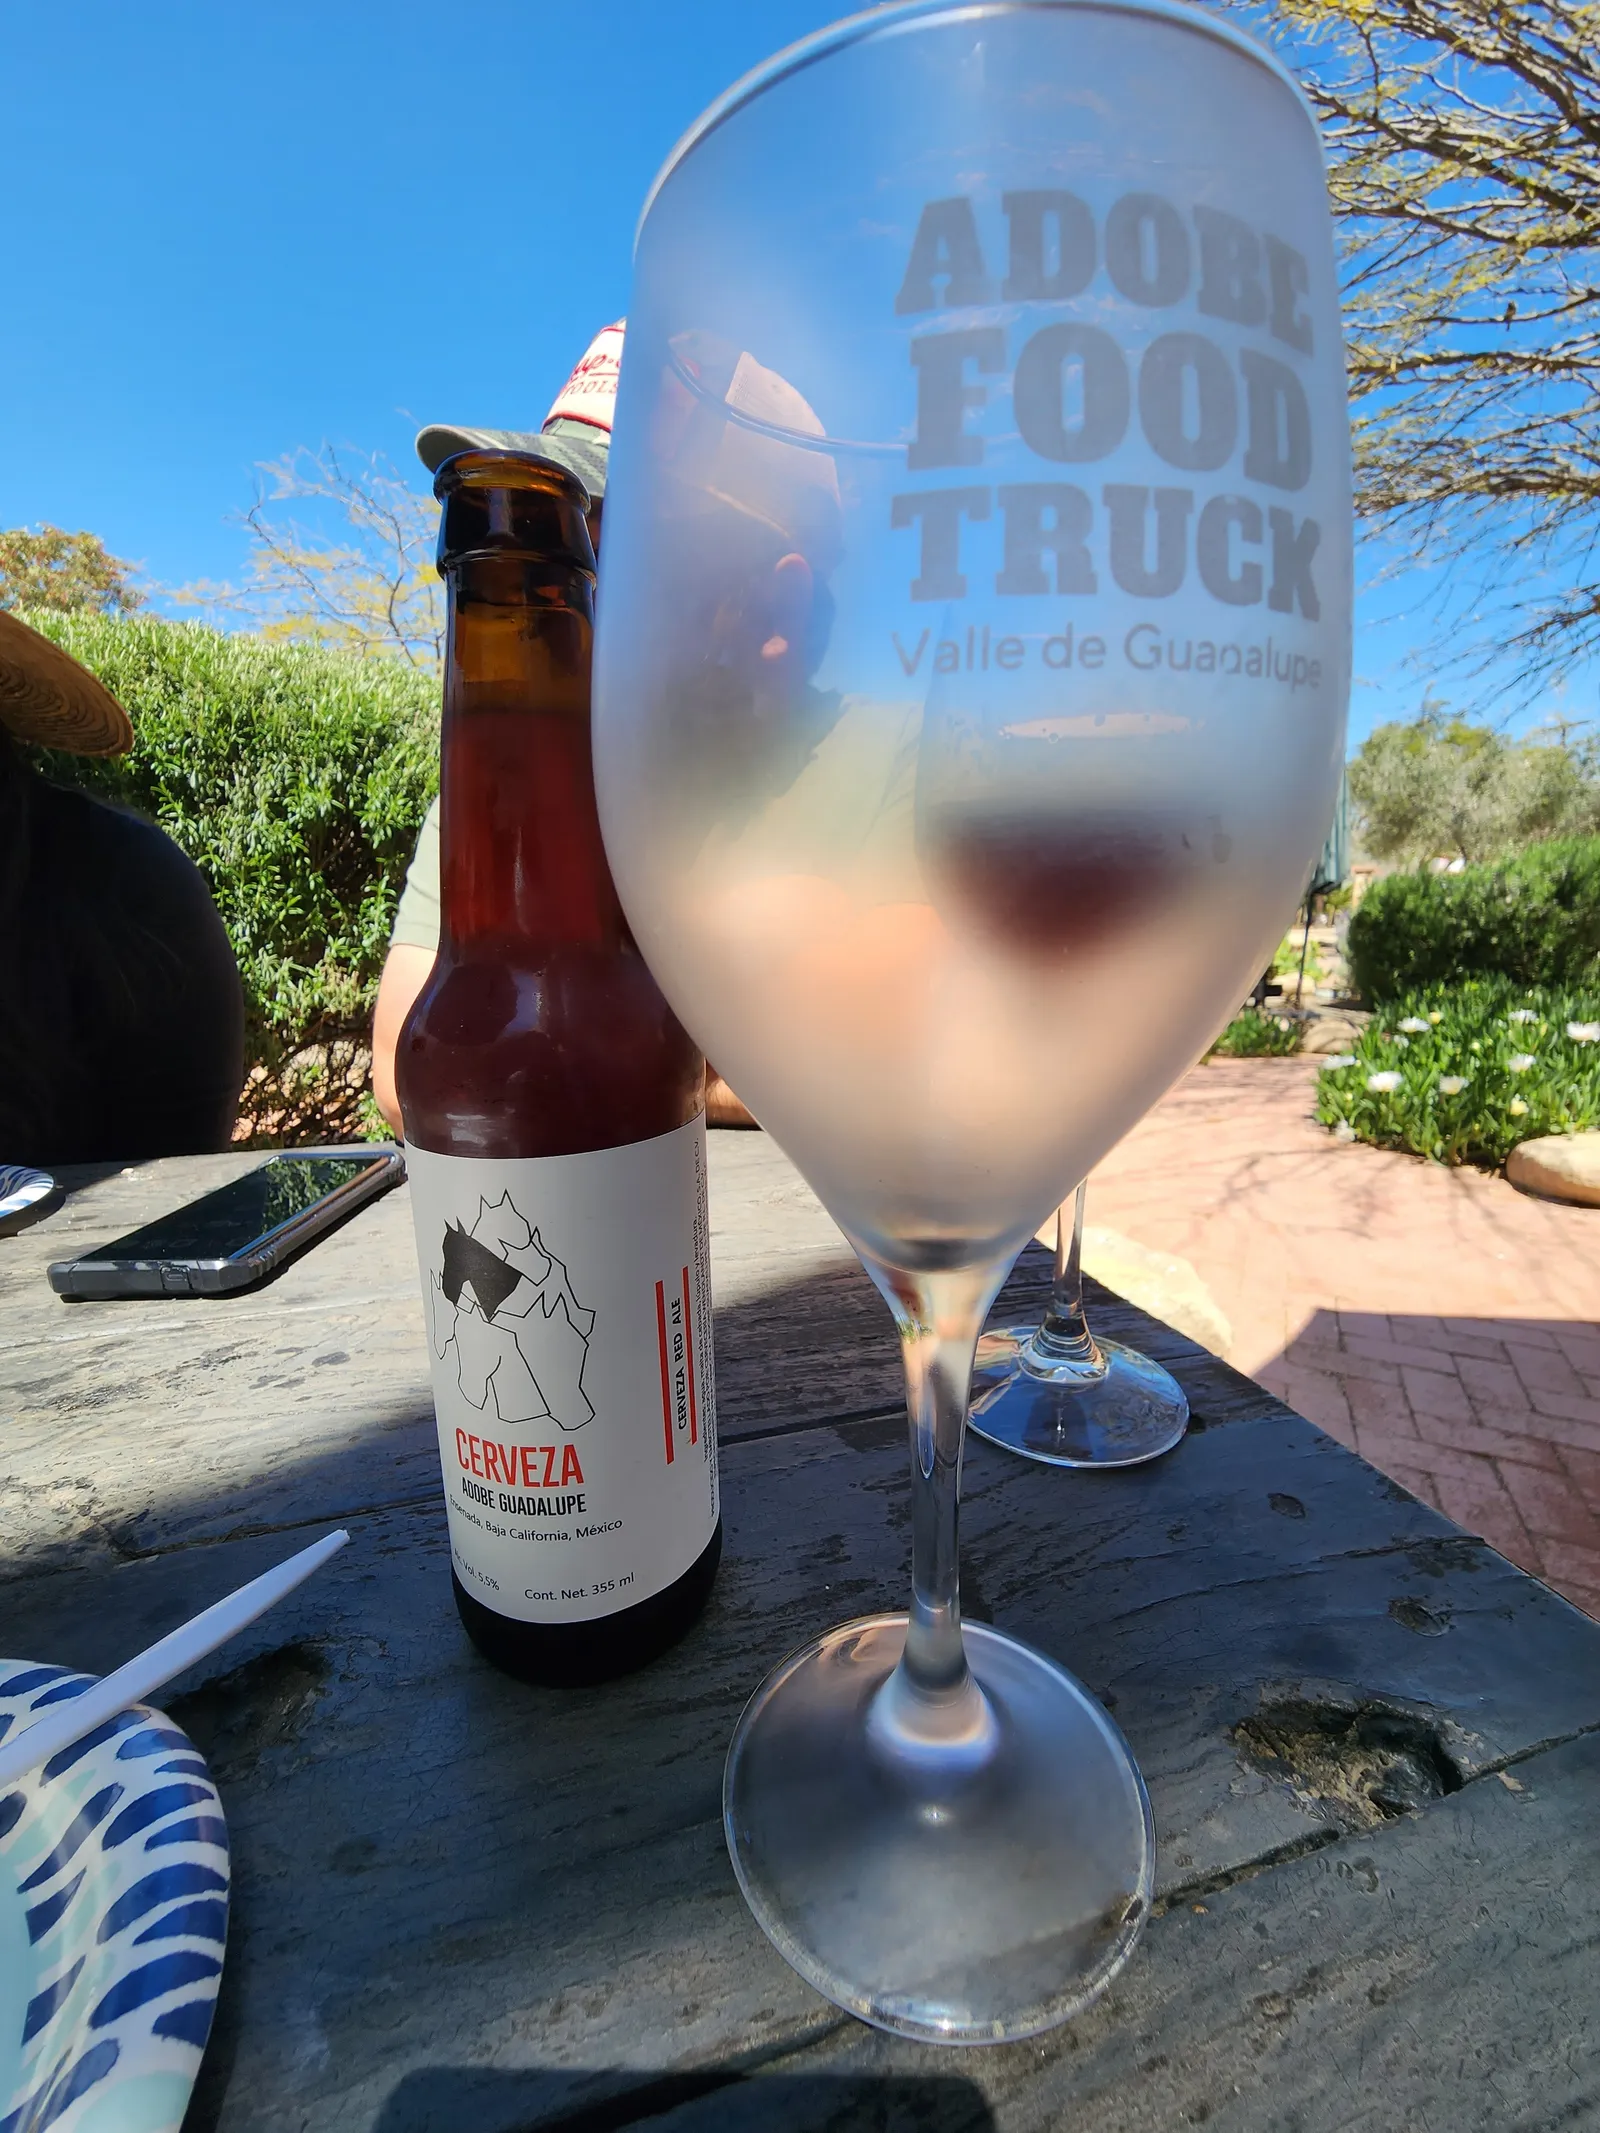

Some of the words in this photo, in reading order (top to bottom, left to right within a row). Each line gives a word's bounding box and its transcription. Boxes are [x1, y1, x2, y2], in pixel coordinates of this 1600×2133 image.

[895, 189, 1314, 358] ADOBE
[906, 321, 1312, 492] FOOD
[889, 481, 1322, 622] TRUCK
[891, 622, 1025, 678] Valle
[1041, 620, 1106, 671] de
[671, 1298, 682, 1325] ALE
[673, 1332, 684, 1362] RED
[673, 1367, 687, 1430] CERVEZA
[455, 1427, 584, 1488] CERVEZA
[462, 1476, 495, 1509] ADOBE
[499, 1493, 587, 1517] GUADALUPE
[485, 1520, 506, 1537] Baja
[509, 1528, 572, 1541] California,
[576, 1519, 623, 1539] México
[463, 1559, 477, 1579] Vol.
[478, 1571, 500, 1591] 5,5%
[524, 1588, 557, 1600] Cont.
[561, 1586, 588, 1600] Net.
[591, 1580, 615, 1596] 355
[619, 1572, 635, 1588] ml
